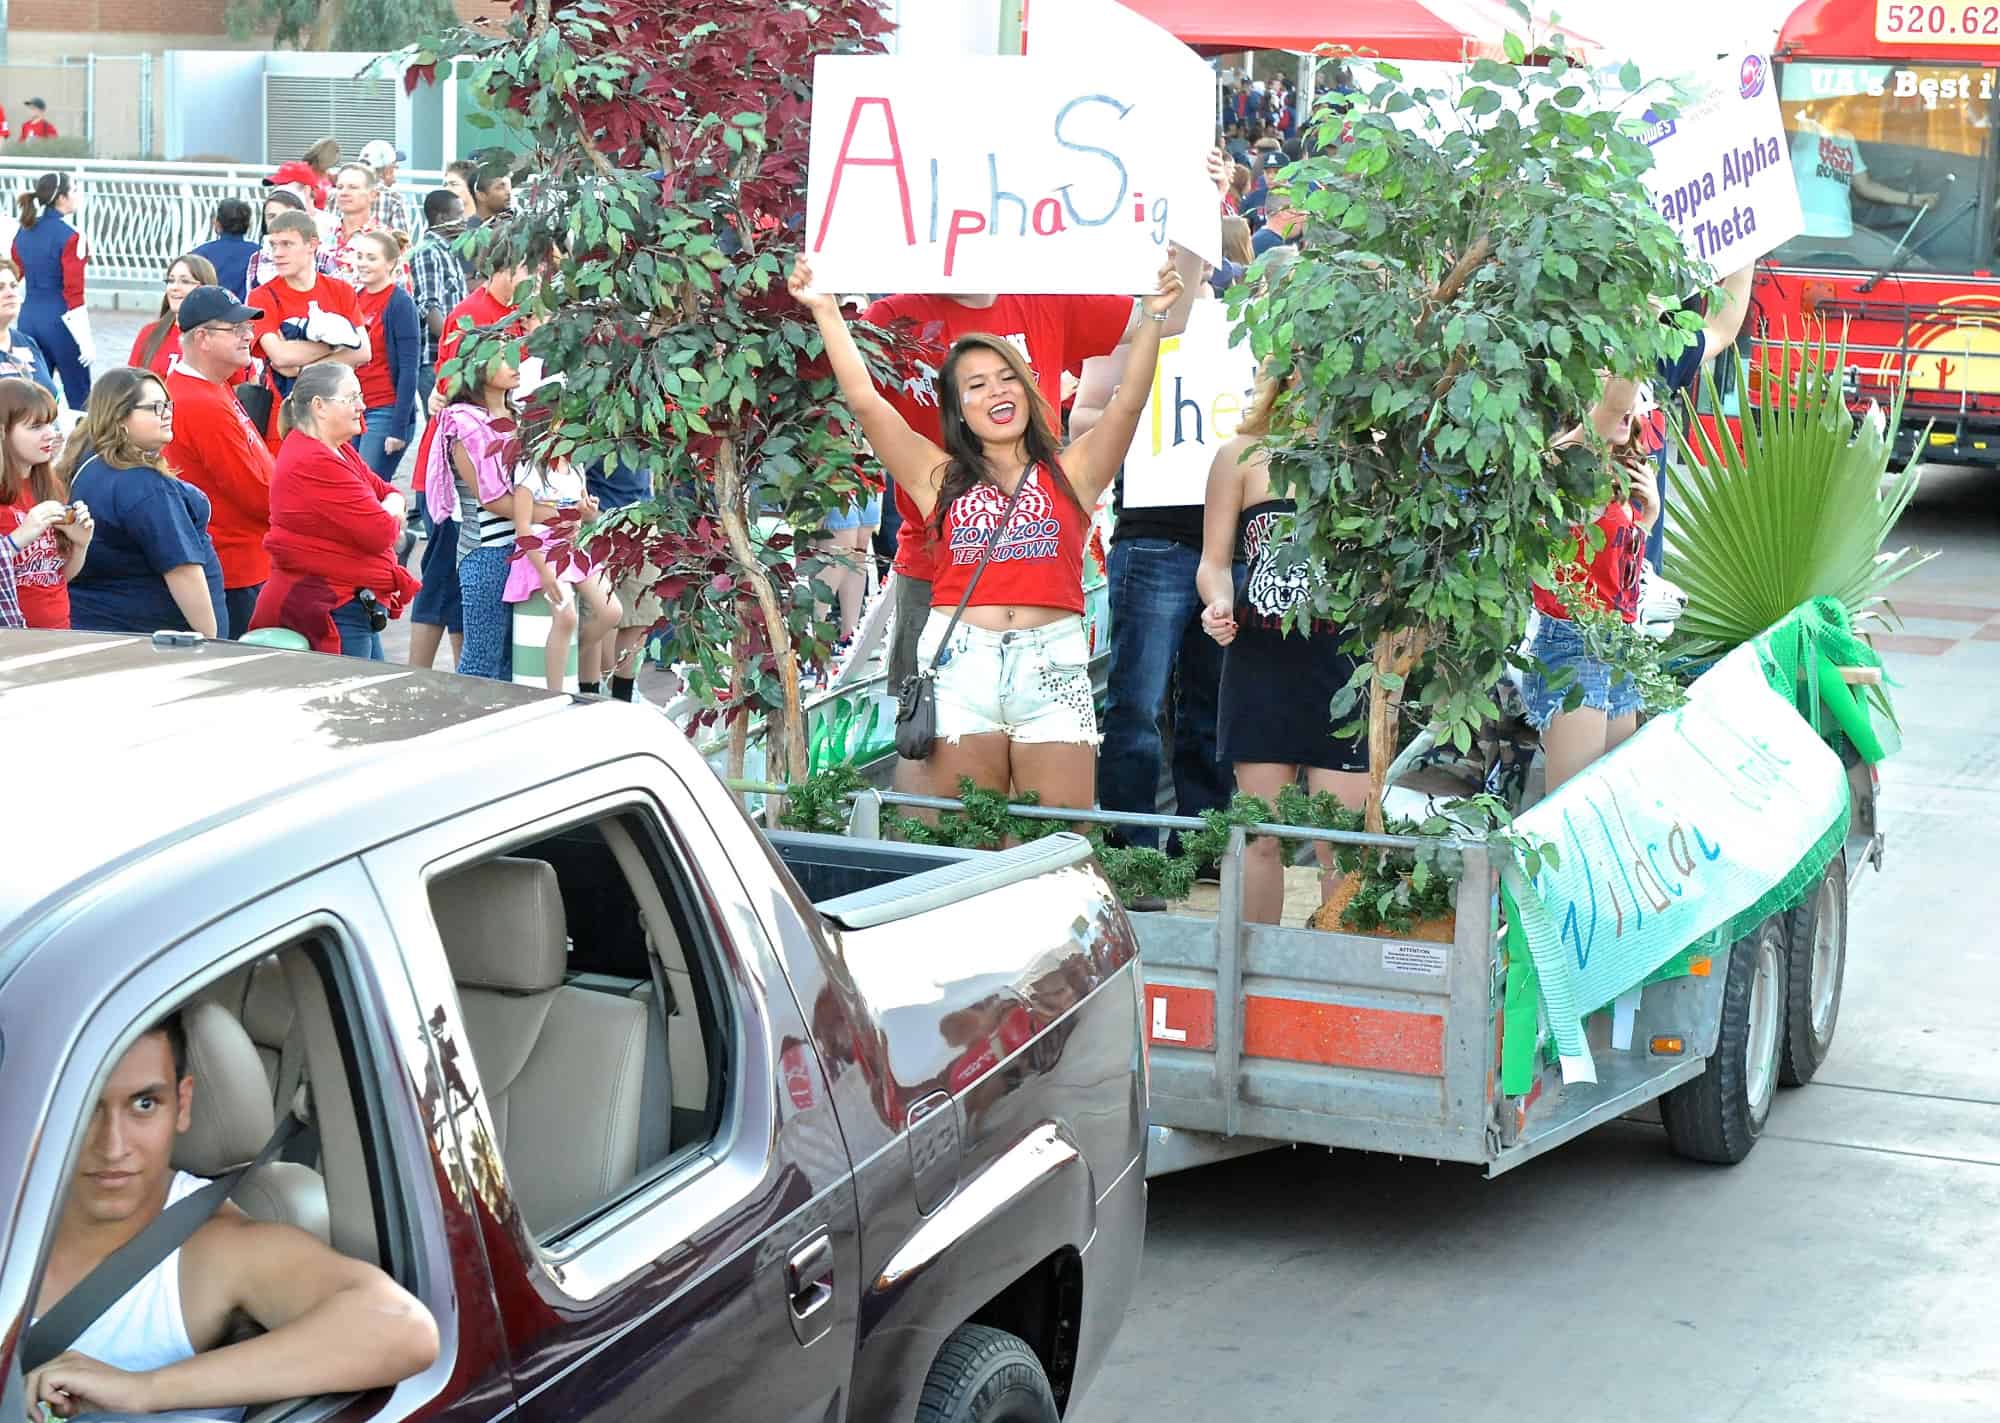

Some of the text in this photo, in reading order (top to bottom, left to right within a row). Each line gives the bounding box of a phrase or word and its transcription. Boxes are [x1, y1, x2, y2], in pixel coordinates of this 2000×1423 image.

[1893, 70, 1971, 99] Best
[1647, 172, 1716, 224] appa
[1723, 136, 1780, 191] Alpha
[1693, 206, 1756, 260] Theta
